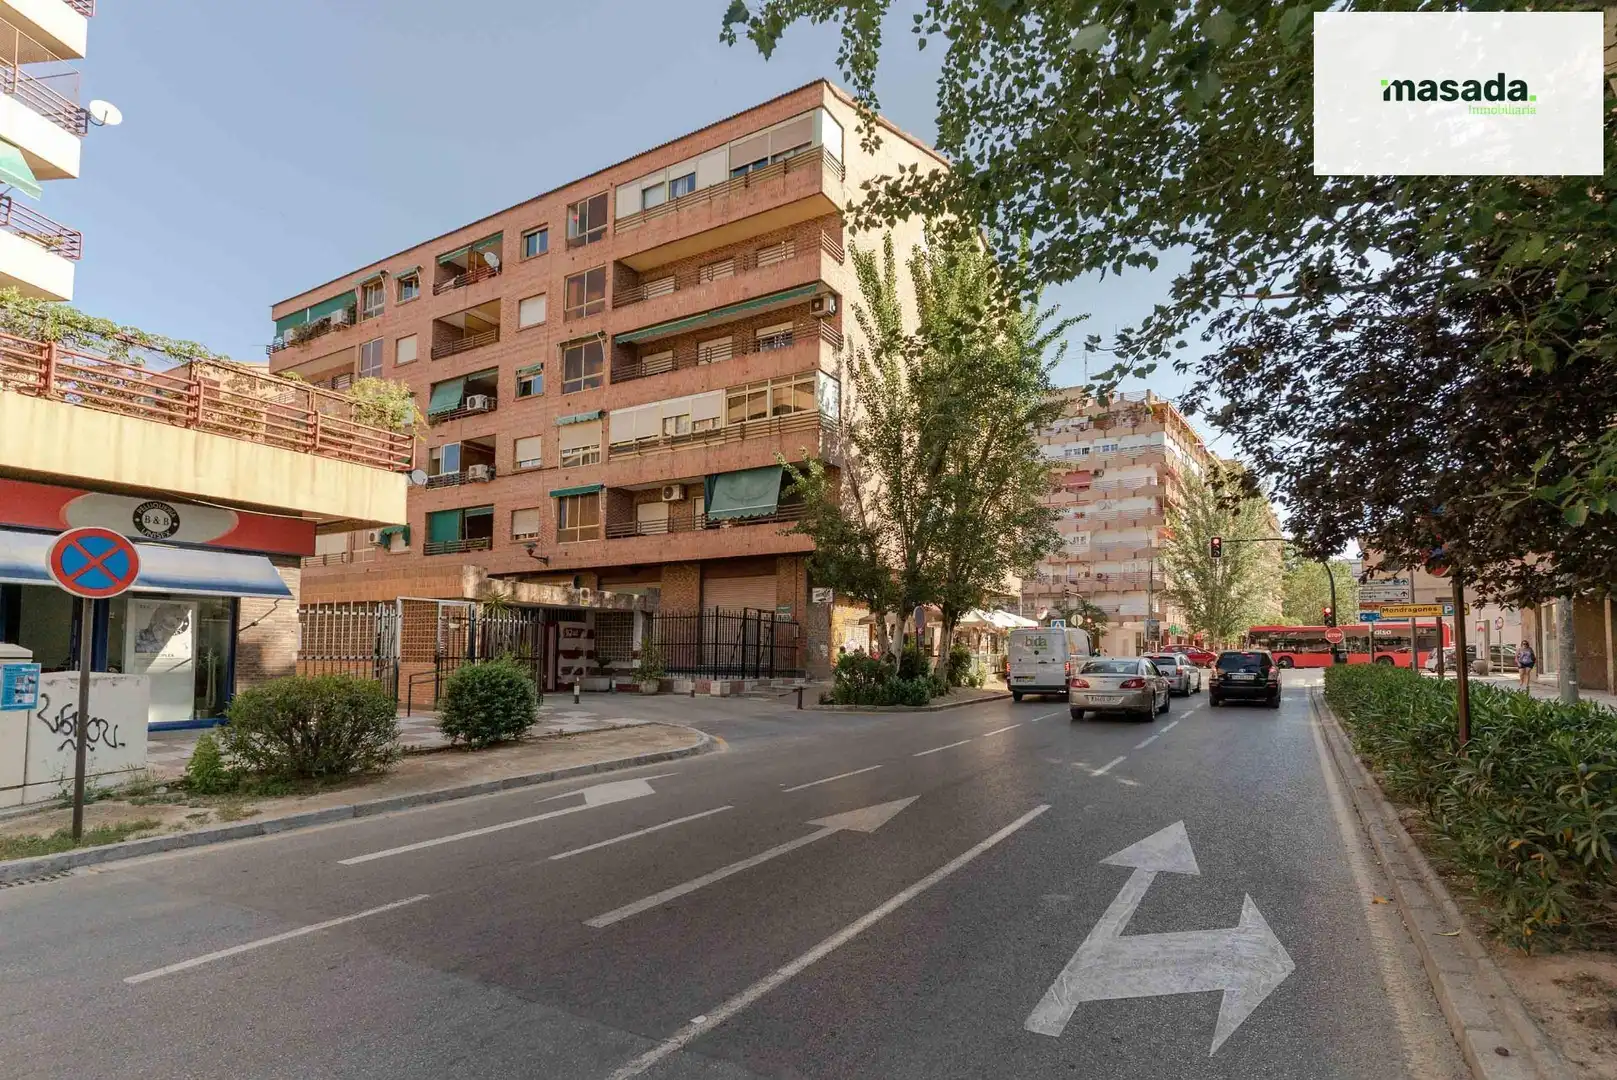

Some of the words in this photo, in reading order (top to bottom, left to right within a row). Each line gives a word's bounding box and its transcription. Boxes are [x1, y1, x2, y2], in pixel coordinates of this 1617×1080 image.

[144, 514, 151, 524] B
[153, 516, 160, 525] &
[163, 517, 169, 526] B
[141, 527, 172, 539] UNISEX
[1382, 606, 1438, 614] Mondragones
